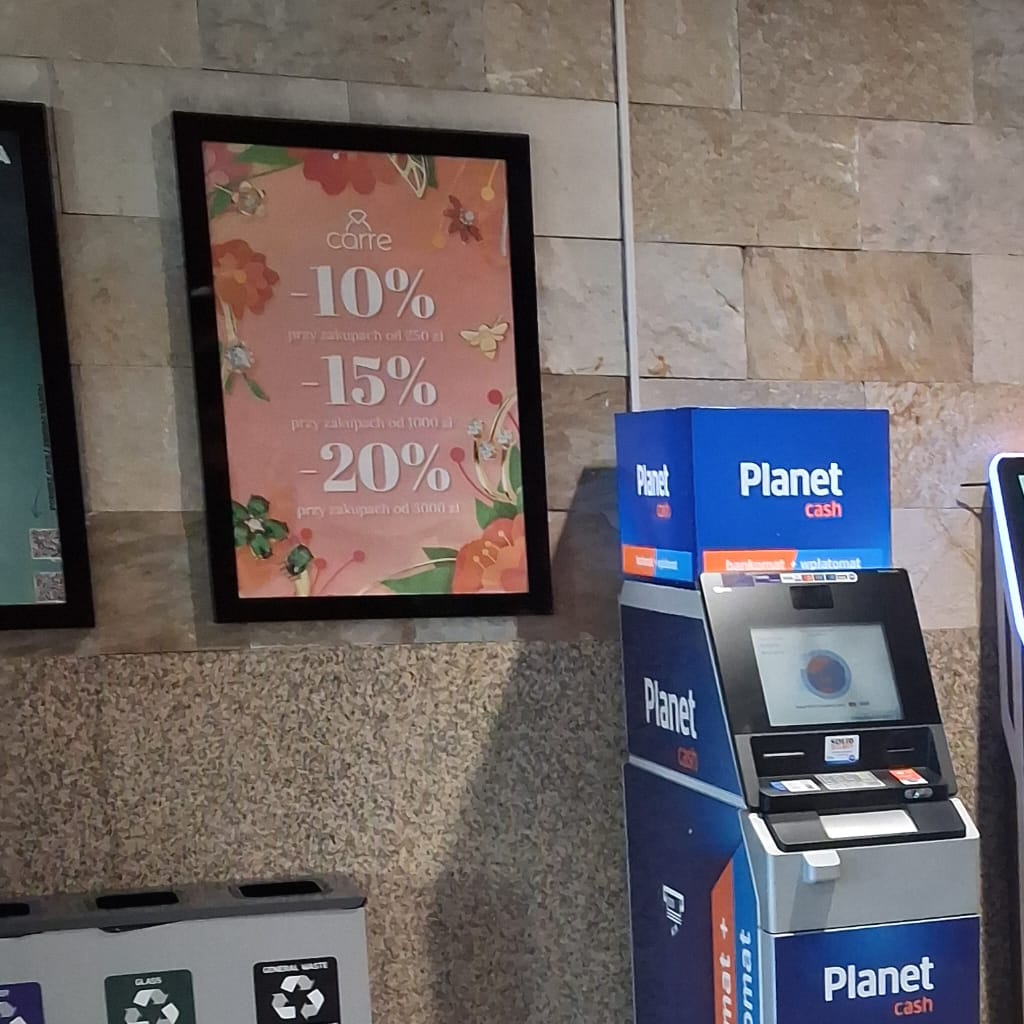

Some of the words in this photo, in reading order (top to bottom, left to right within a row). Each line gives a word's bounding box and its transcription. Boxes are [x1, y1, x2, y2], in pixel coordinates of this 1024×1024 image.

[326, 231, 393, 251] carre
[289, 265, 436, 320] -10%
[386, 330, 401, 341] od
[300, 355, 437, 406] -15%
[388, 416, 404, 429] od
[299, 442, 451, 494] -20%
[636, 463, 670, 498] Planet
[739, 461, 844, 497] Planet
[393, 503, 410, 515] od
[804, 500, 843, 518] cash
[643, 676, 698, 740] Planet
[824, 956, 935, 1001] Planet
[894, 996, 933, 1016] cash
